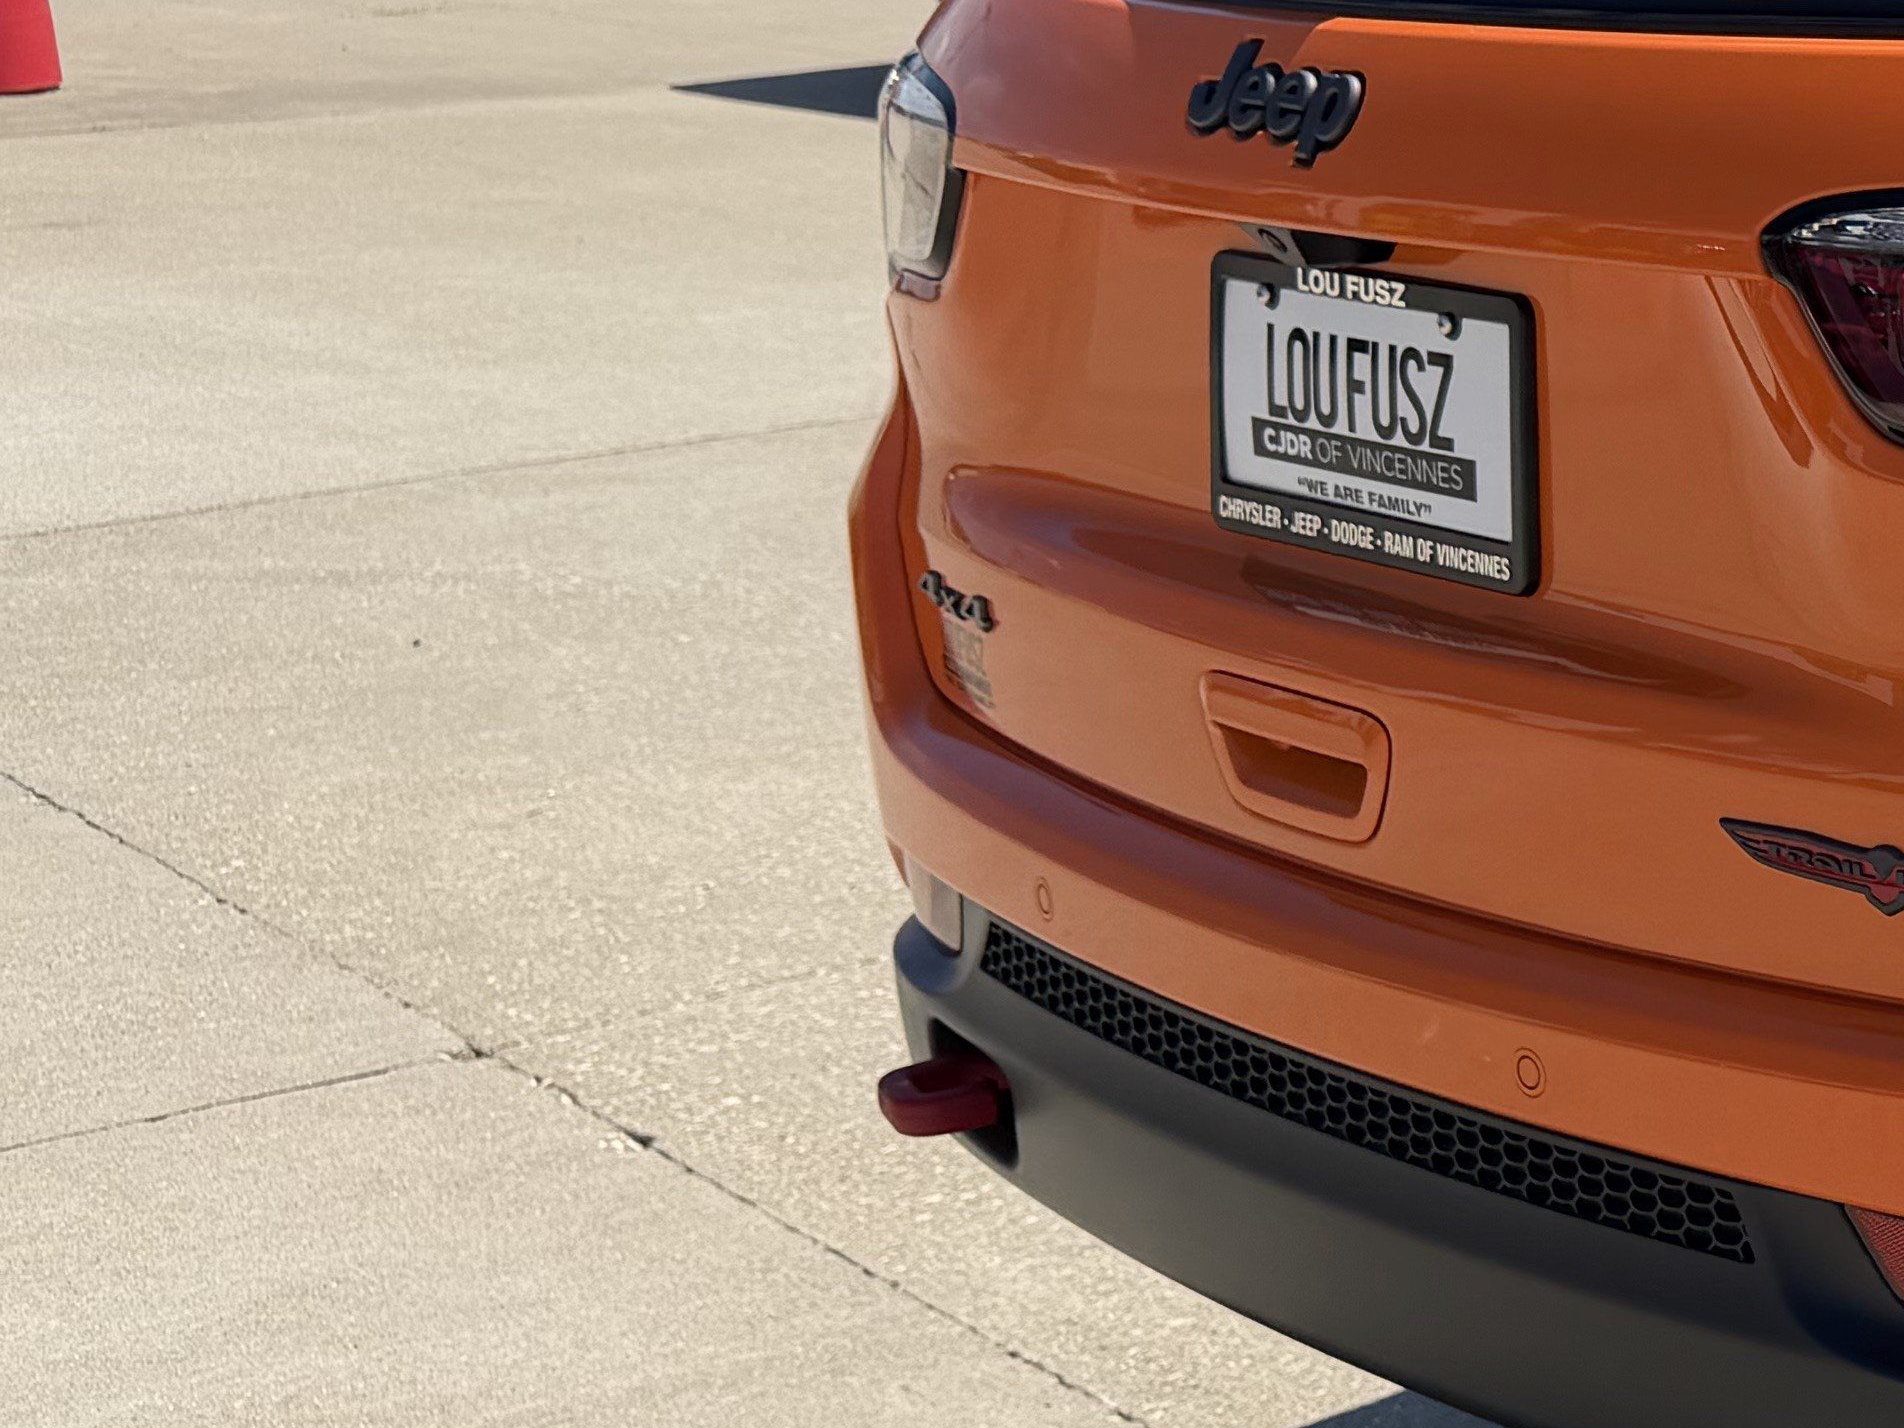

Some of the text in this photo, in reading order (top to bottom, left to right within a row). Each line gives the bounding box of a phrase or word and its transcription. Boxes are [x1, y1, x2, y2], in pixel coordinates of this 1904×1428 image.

[1187, 38, 1366, 166] Jeep
[1296, 267, 1406, 307] LOU FUSZ
[1263, 428, 1464, 491] CJDR OF VINCENNES
[1333, 485, 1364, 504] ARE
[1219, 495, 1511, 582] CHRYSLER JEEP DODGE RAM OF VINCENNES
[919, 569, 994, 634] 4x4
